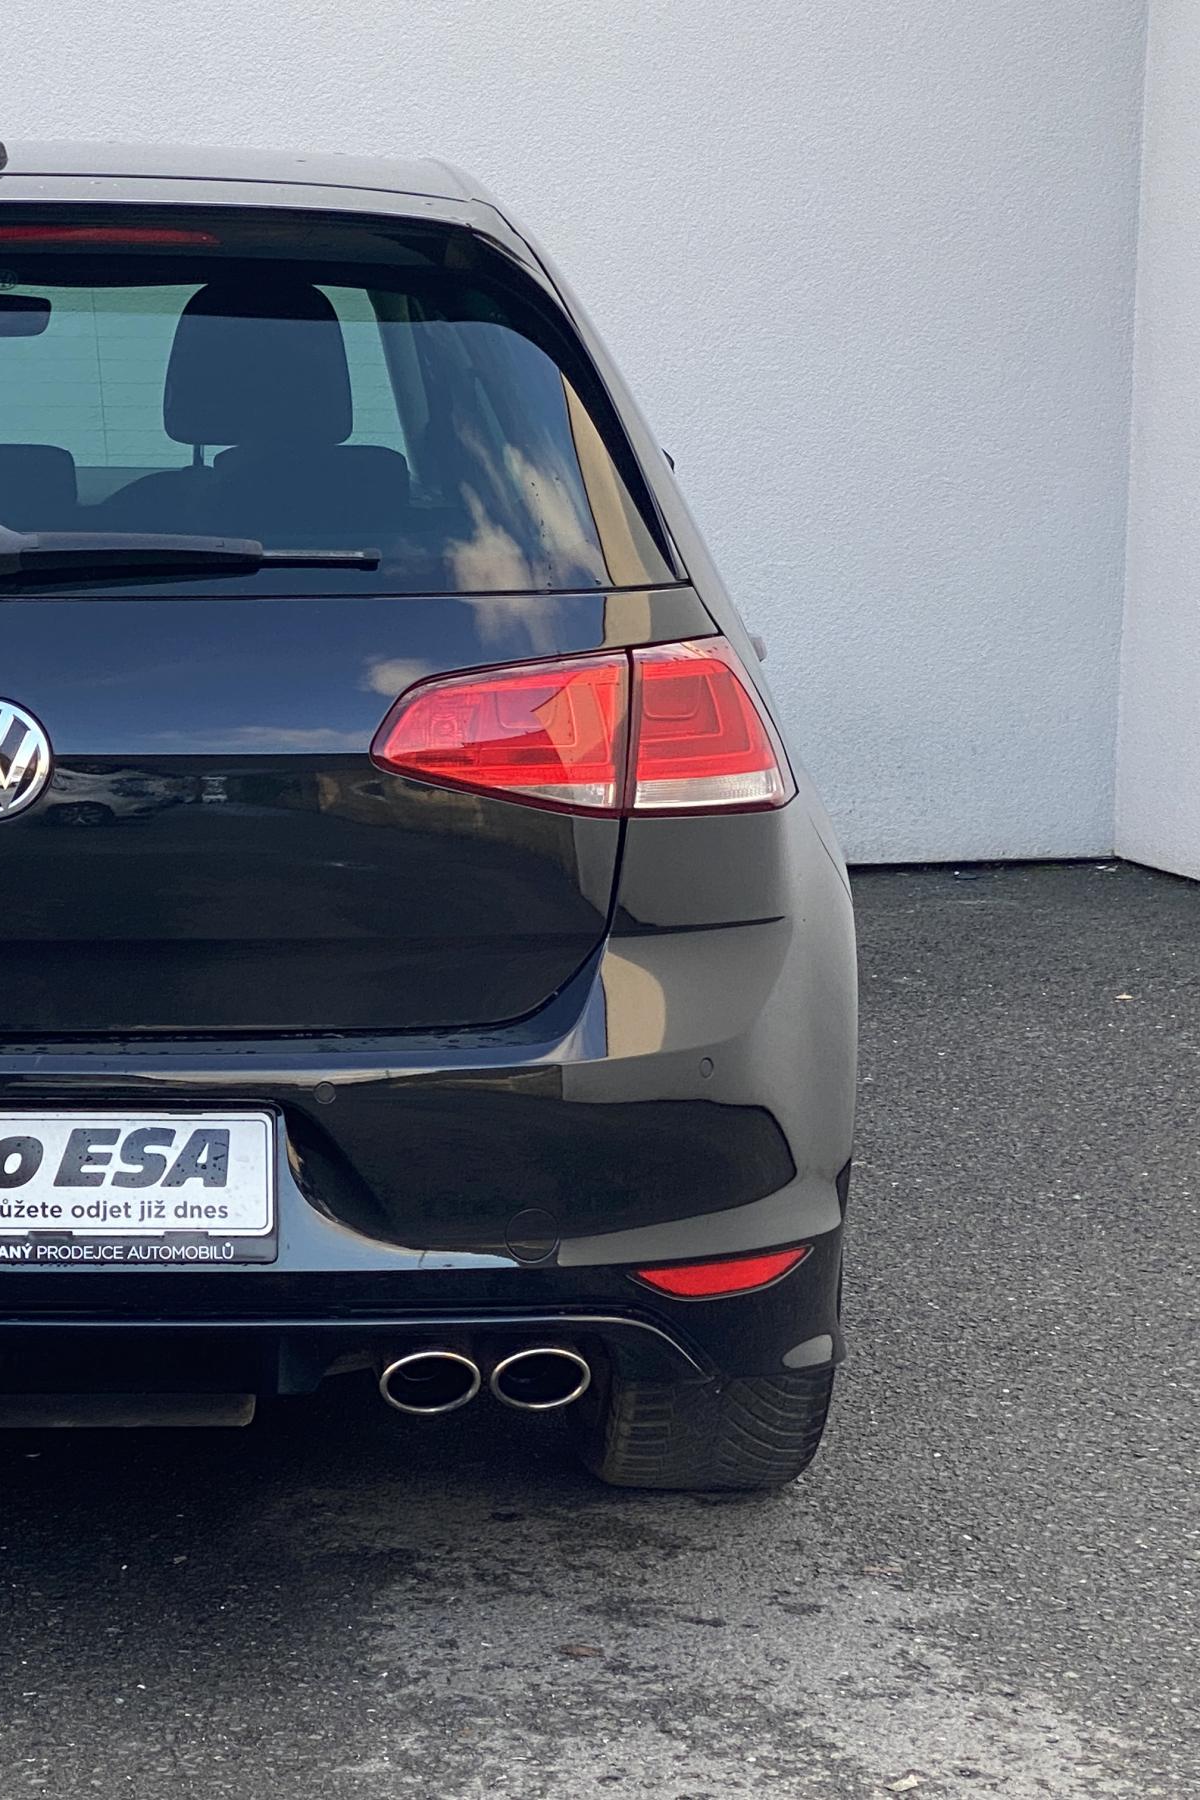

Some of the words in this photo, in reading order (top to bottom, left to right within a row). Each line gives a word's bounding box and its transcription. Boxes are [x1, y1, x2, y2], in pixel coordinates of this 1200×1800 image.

[53, 1126, 231, 1189] ESA
[71, 1200, 132, 1222] odjet
[138, 1200, 166, 1222] již
[174, 1200, 228, 1219] dnes
[36, 1245, 124, 1260] PRODEJCE
[126, 1241, 235, 1260] AUTOMOBILŮ
